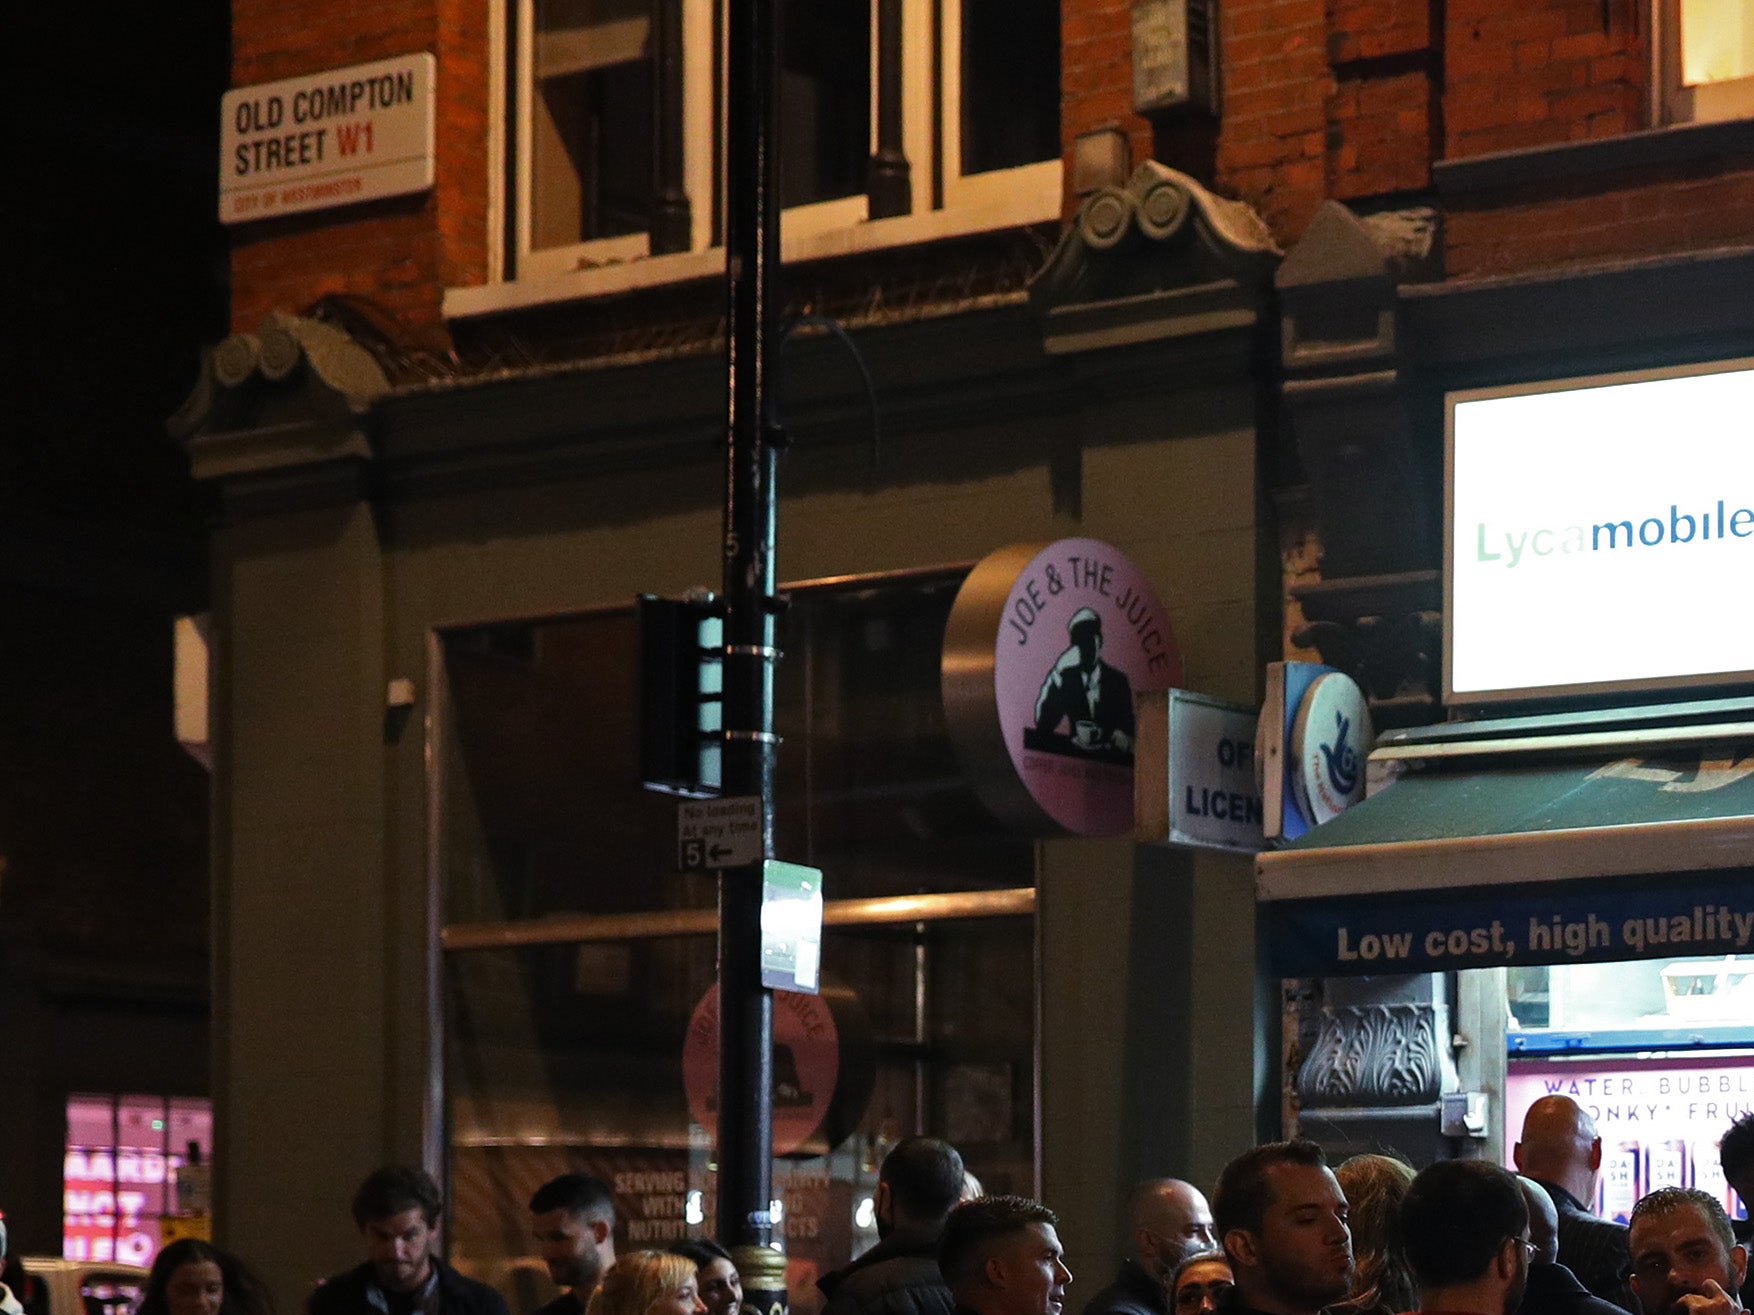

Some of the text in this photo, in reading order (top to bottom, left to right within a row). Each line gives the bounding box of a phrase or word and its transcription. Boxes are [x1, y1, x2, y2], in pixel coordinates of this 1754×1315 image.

[235, 70, 414, 135] OLD COMPTON
[235, 122, 374, 176] STREET W1
[1009, 556, 1168, 671] JOE & THE JUICE
[1217, 737, 1254, 768] OF
[1186, 784, 1264, 825] LICEN
[1338, 927, 1412, 962] Low
[1425, 919, 1514, 960] cost,
[1529, 916, 1610, 957] high
[1623, 904, 1754, 954] quality
